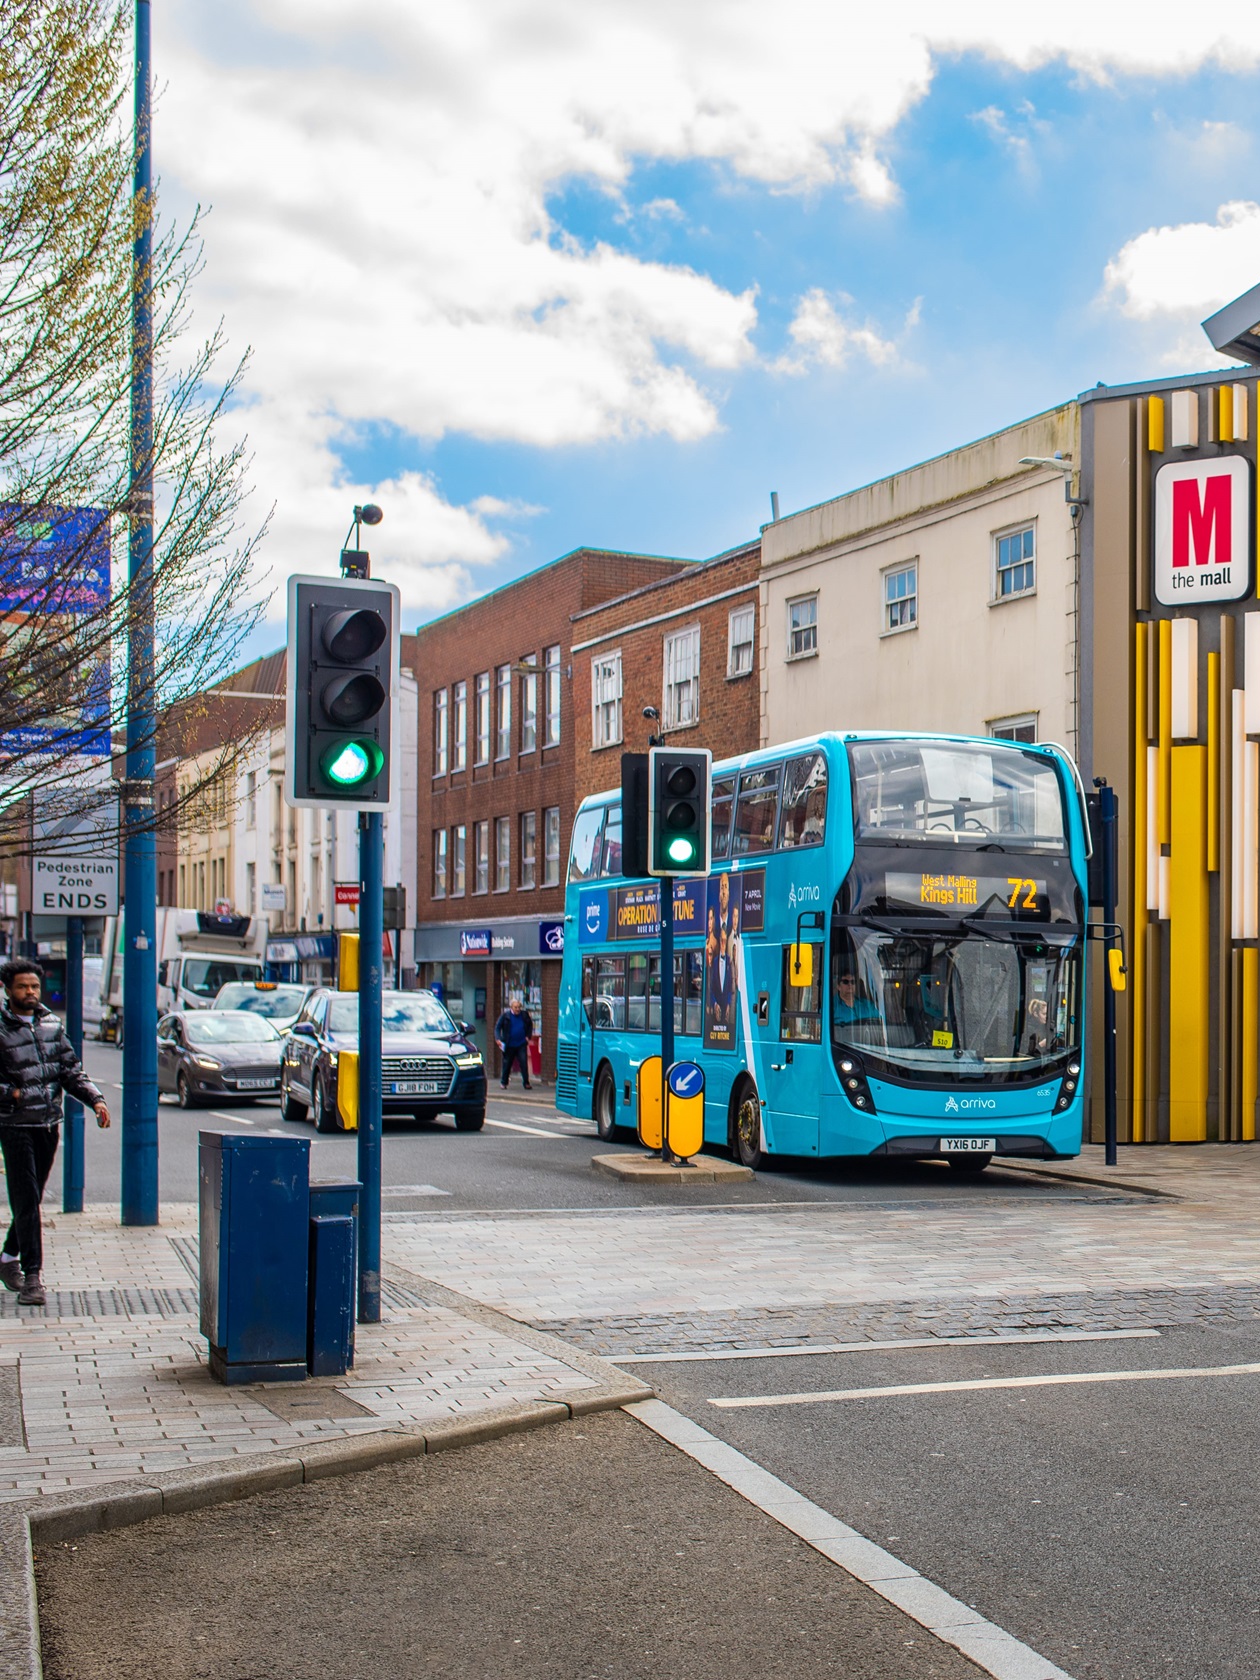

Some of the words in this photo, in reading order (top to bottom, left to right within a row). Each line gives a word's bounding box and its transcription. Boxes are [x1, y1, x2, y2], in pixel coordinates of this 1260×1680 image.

[1172, 474, 1232, 568] M
[1172, 572, 1195, 589] the
[1200, 567, 1232, 586] mall
[37, 861, 114, 874] Pedestrian
[58, 875, 93, 887] Zone
[922, 874, 945, 887] West
[947, 875, 977, 888] Malling
[43, 893, 107, 909] ENDS
[921, 886, 955, 904] Kings
[957, 887, 978, 904] Hill
[1007, 878, 1038, 909] 72
[586, 901, 600, 921] prime
[617, 903, 657, 926] OPERATION
[673, 899, 695, 921] TUNE
[960, 1097, 996, 1109] arriva
[946, 1139, 969, 1150] YX16
[971, 1139, 990, 1150] OJF
